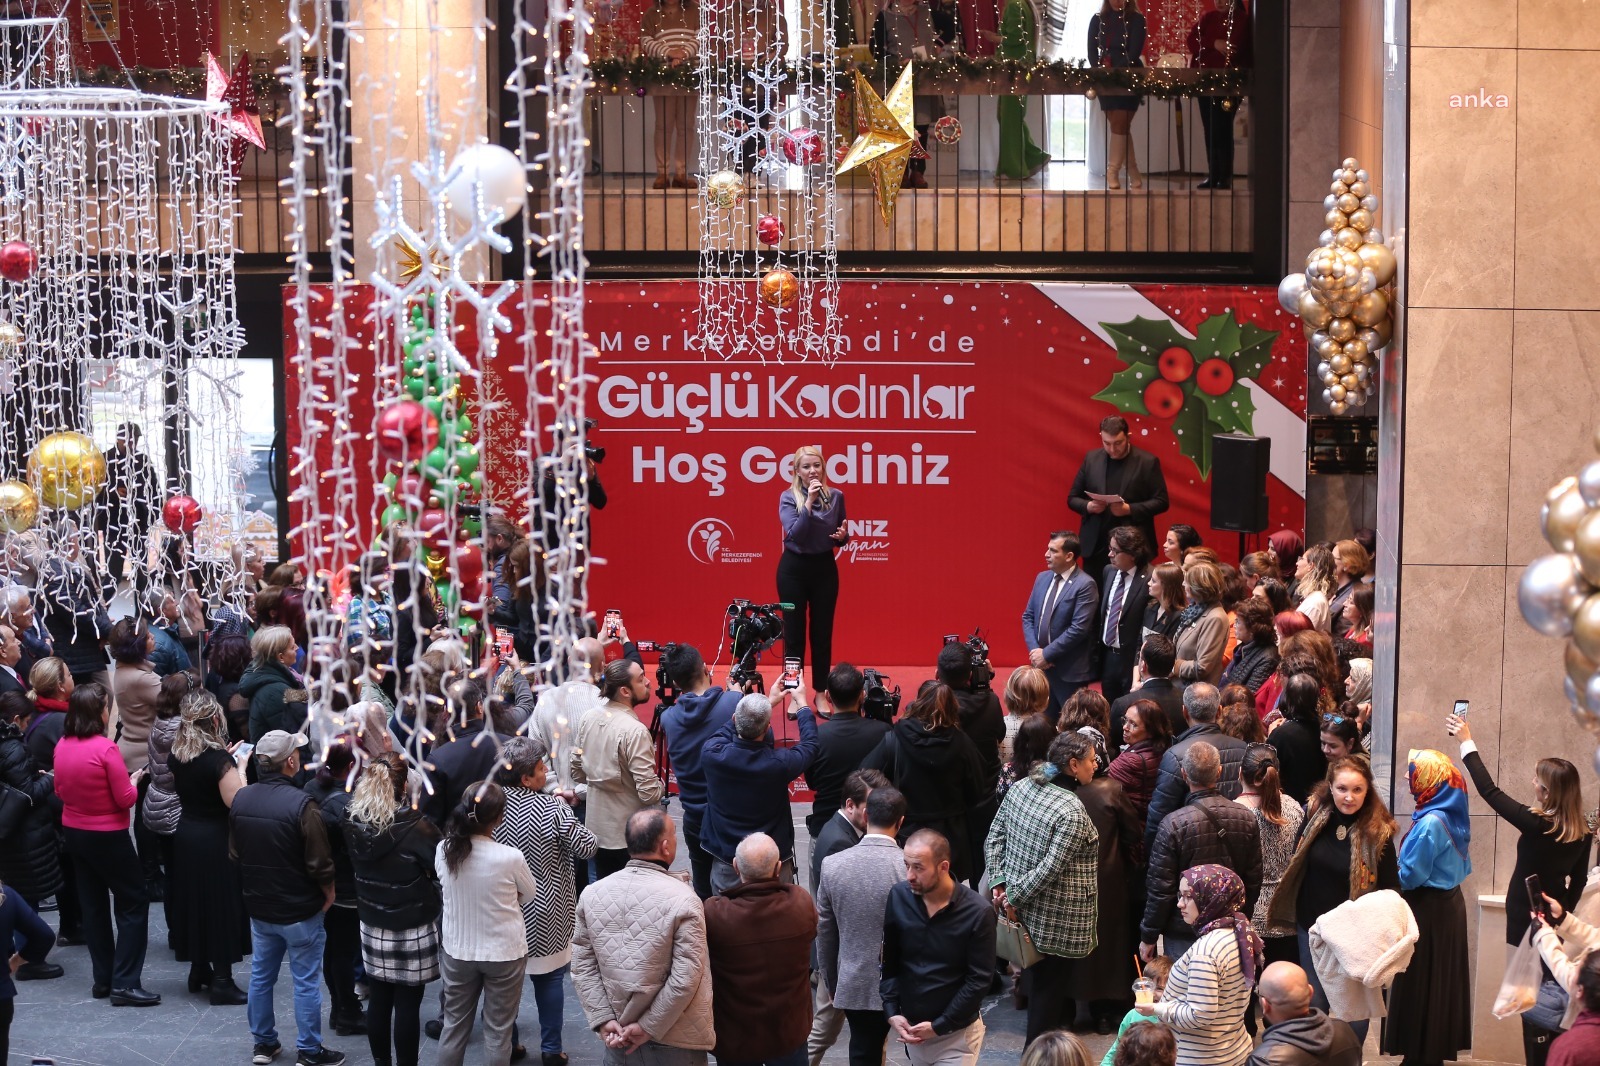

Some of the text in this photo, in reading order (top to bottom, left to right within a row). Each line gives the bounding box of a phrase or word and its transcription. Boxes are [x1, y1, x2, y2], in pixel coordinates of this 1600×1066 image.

[597, 371, 975, 434] Güçlü Kadınlar
[632, 441, 950, 497] Hoş Gediniz
